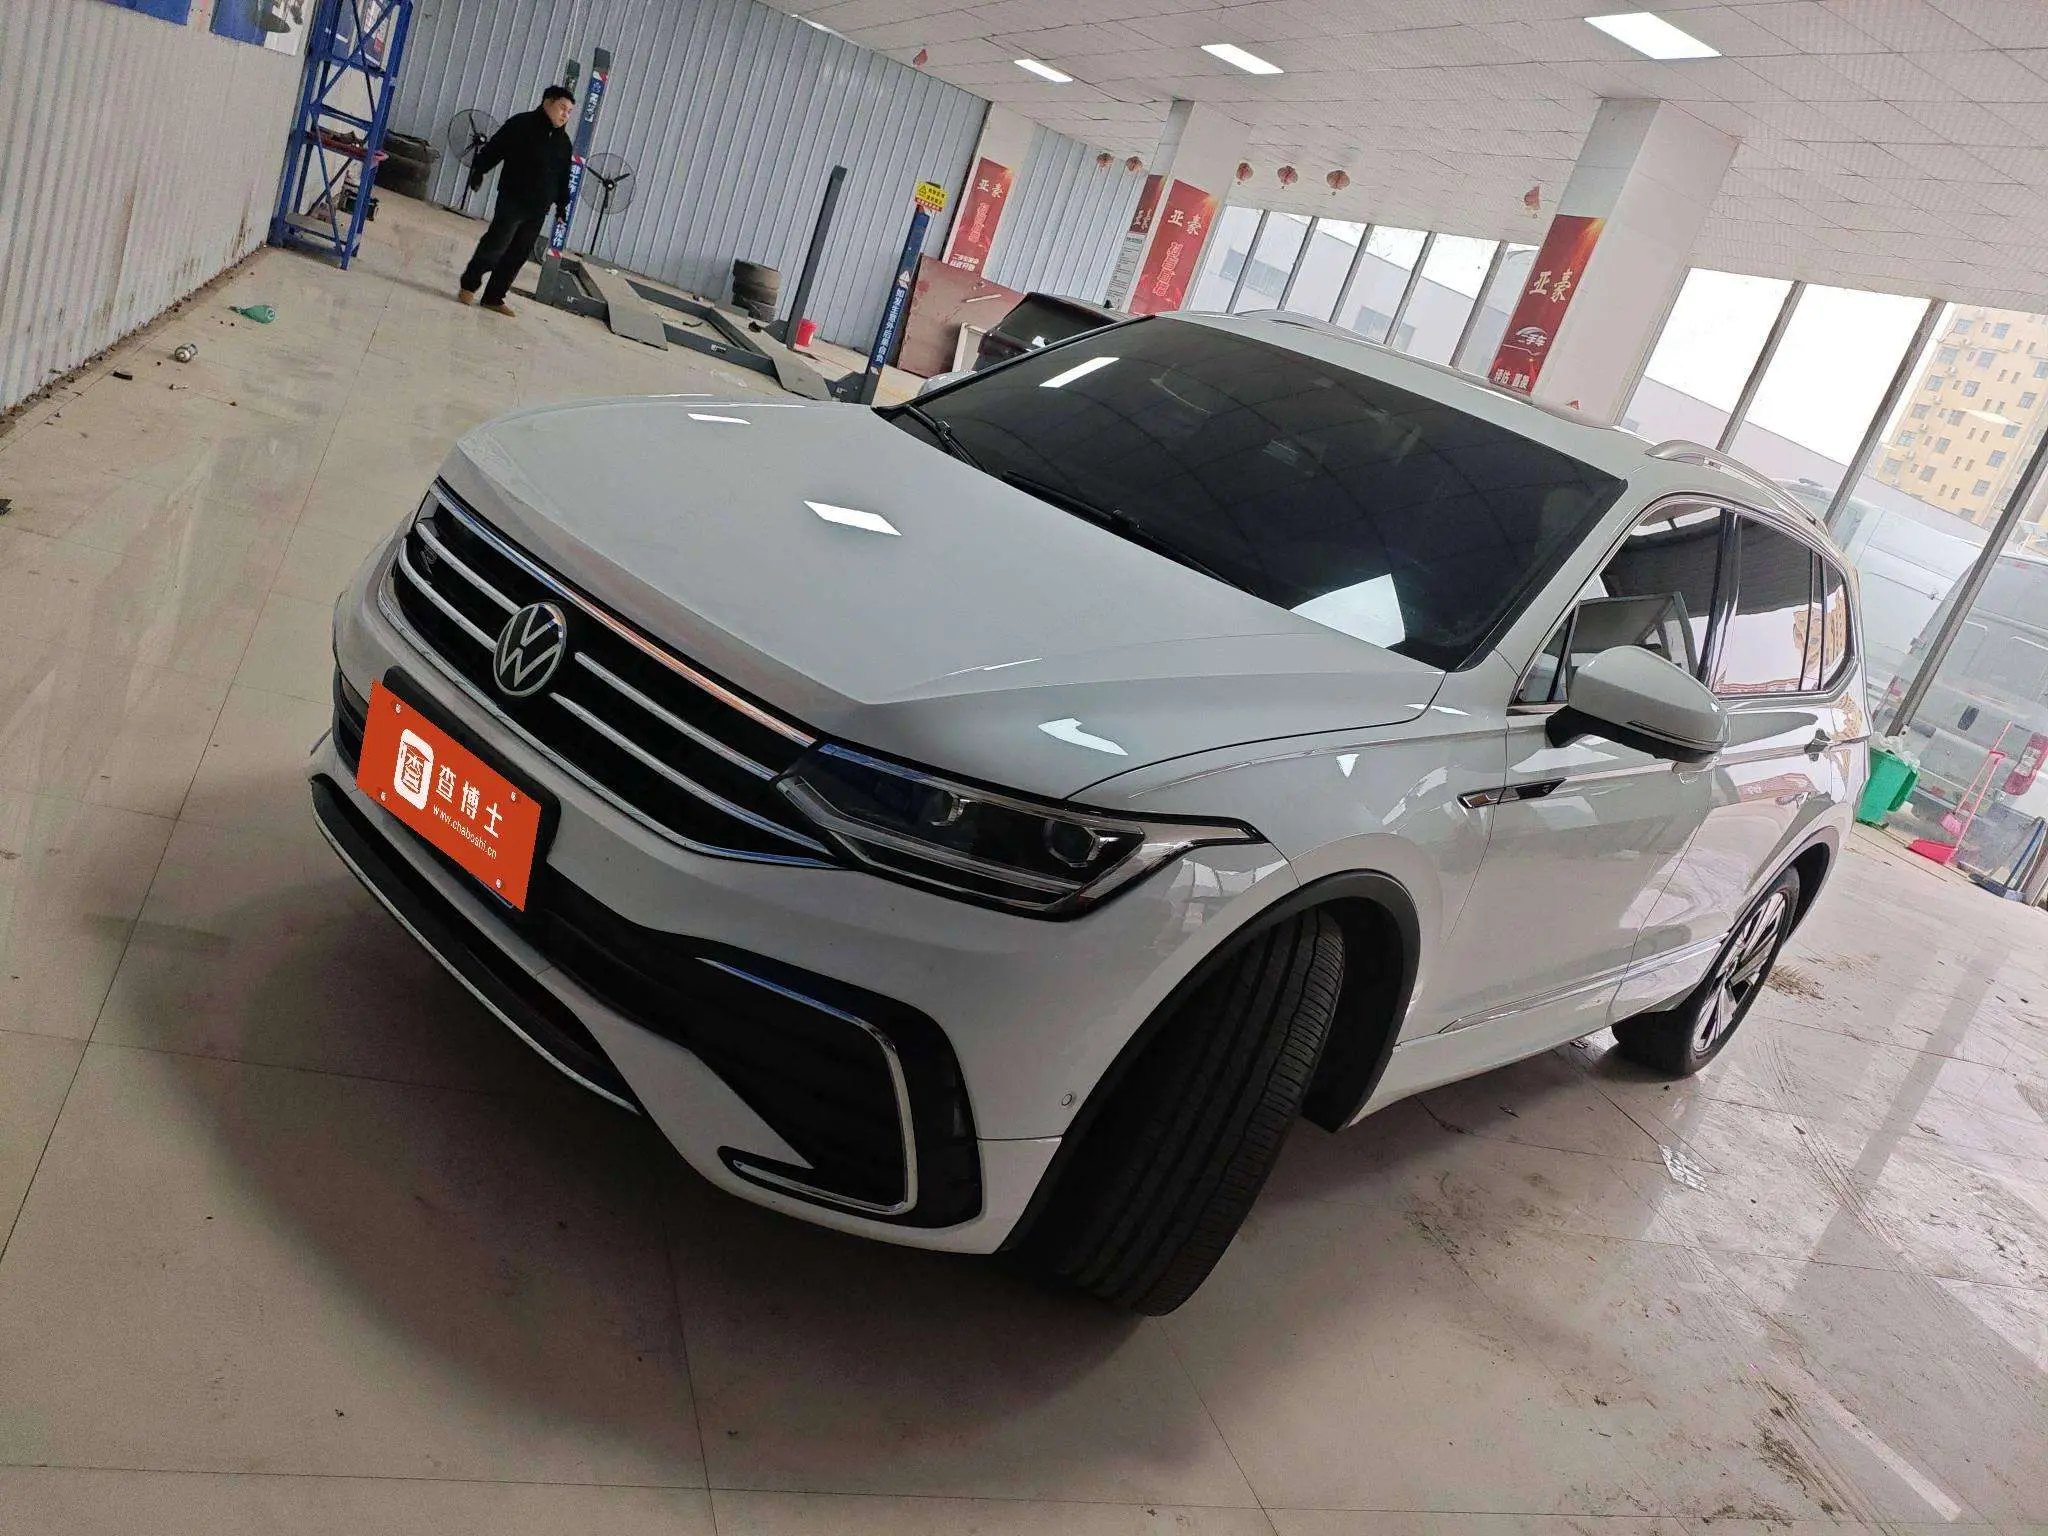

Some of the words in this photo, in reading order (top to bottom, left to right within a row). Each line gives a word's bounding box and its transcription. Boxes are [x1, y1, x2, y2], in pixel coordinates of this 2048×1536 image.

[1168, 209, 1202, 236] 亚豪
[1529, 268, 1573, 302] 亚豪
[1517, 334, 1547, 347] 二手车
